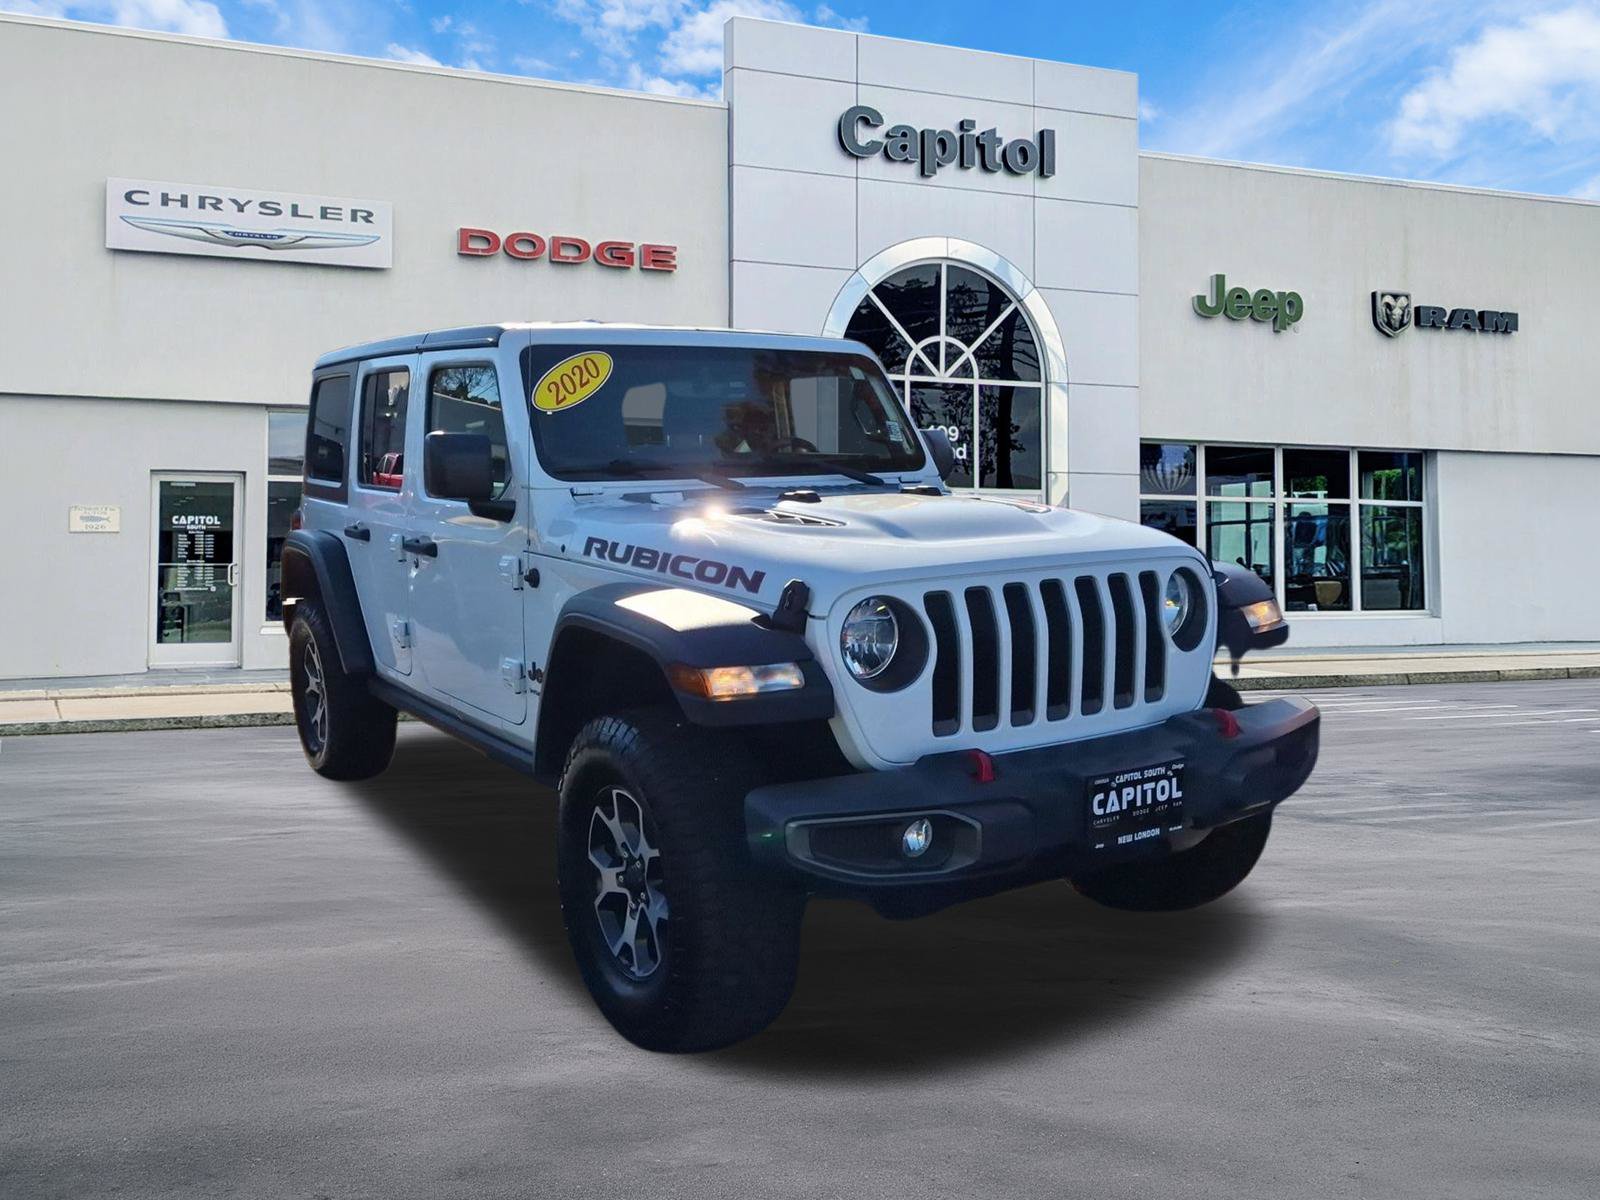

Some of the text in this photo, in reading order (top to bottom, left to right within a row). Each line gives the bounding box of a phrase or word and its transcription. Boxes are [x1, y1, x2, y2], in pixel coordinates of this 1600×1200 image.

[838, 105, 1056, 178] Capitol
[124, 190, 375, 224] CHRYSLER
[457, 227, 678, 272] DODGE
[1192, 274, 1304, 333] Jeep
[1414, 305, 1519, 333] RAM
[547, 357, 601, 405] 2020
[172, 515, 221, 525] CAPITOL
[583, 536, 766, 594] RUBICON
[1115, 771, 1142, 783] CAPITOL
[1143, 767, 1166, 778] SOUTH
[1092, 777, 1183, 816] CAPITOL
[1117, 834, 1133, 845] NEW
[1134, 828, 1160, 841] LONDON
